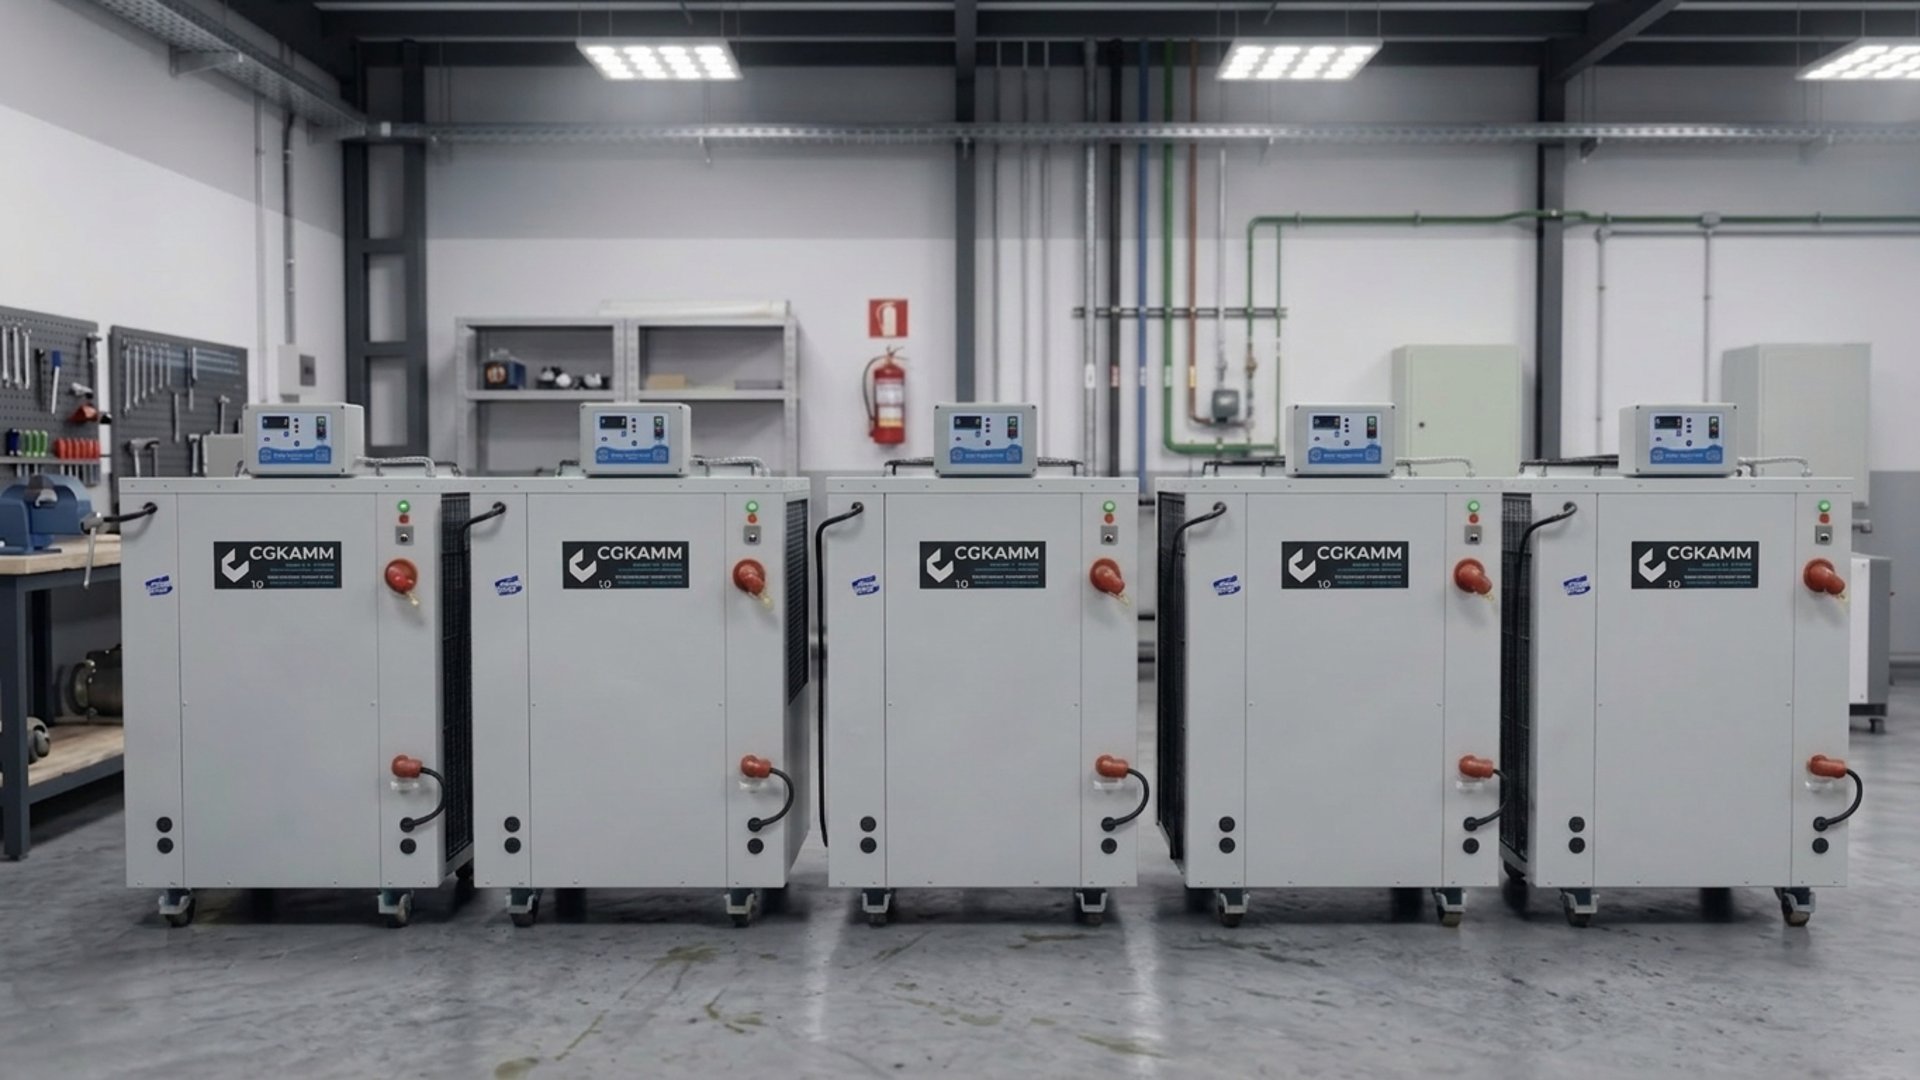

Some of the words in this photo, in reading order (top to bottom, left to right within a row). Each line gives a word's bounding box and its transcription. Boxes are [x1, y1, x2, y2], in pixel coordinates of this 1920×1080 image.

[250, 546, 334, 560] CGKAMM
[597, 546, 682, 560] CGKAMM
[955, 546, 1039, 560] CGKAMM
[1317, 546, 1402, 560] CGKAMM
[1667, 546, 1751, 560] CGKAMM
[251, 580, 264, 589] 10
[955, 580, 969, 589] 10
